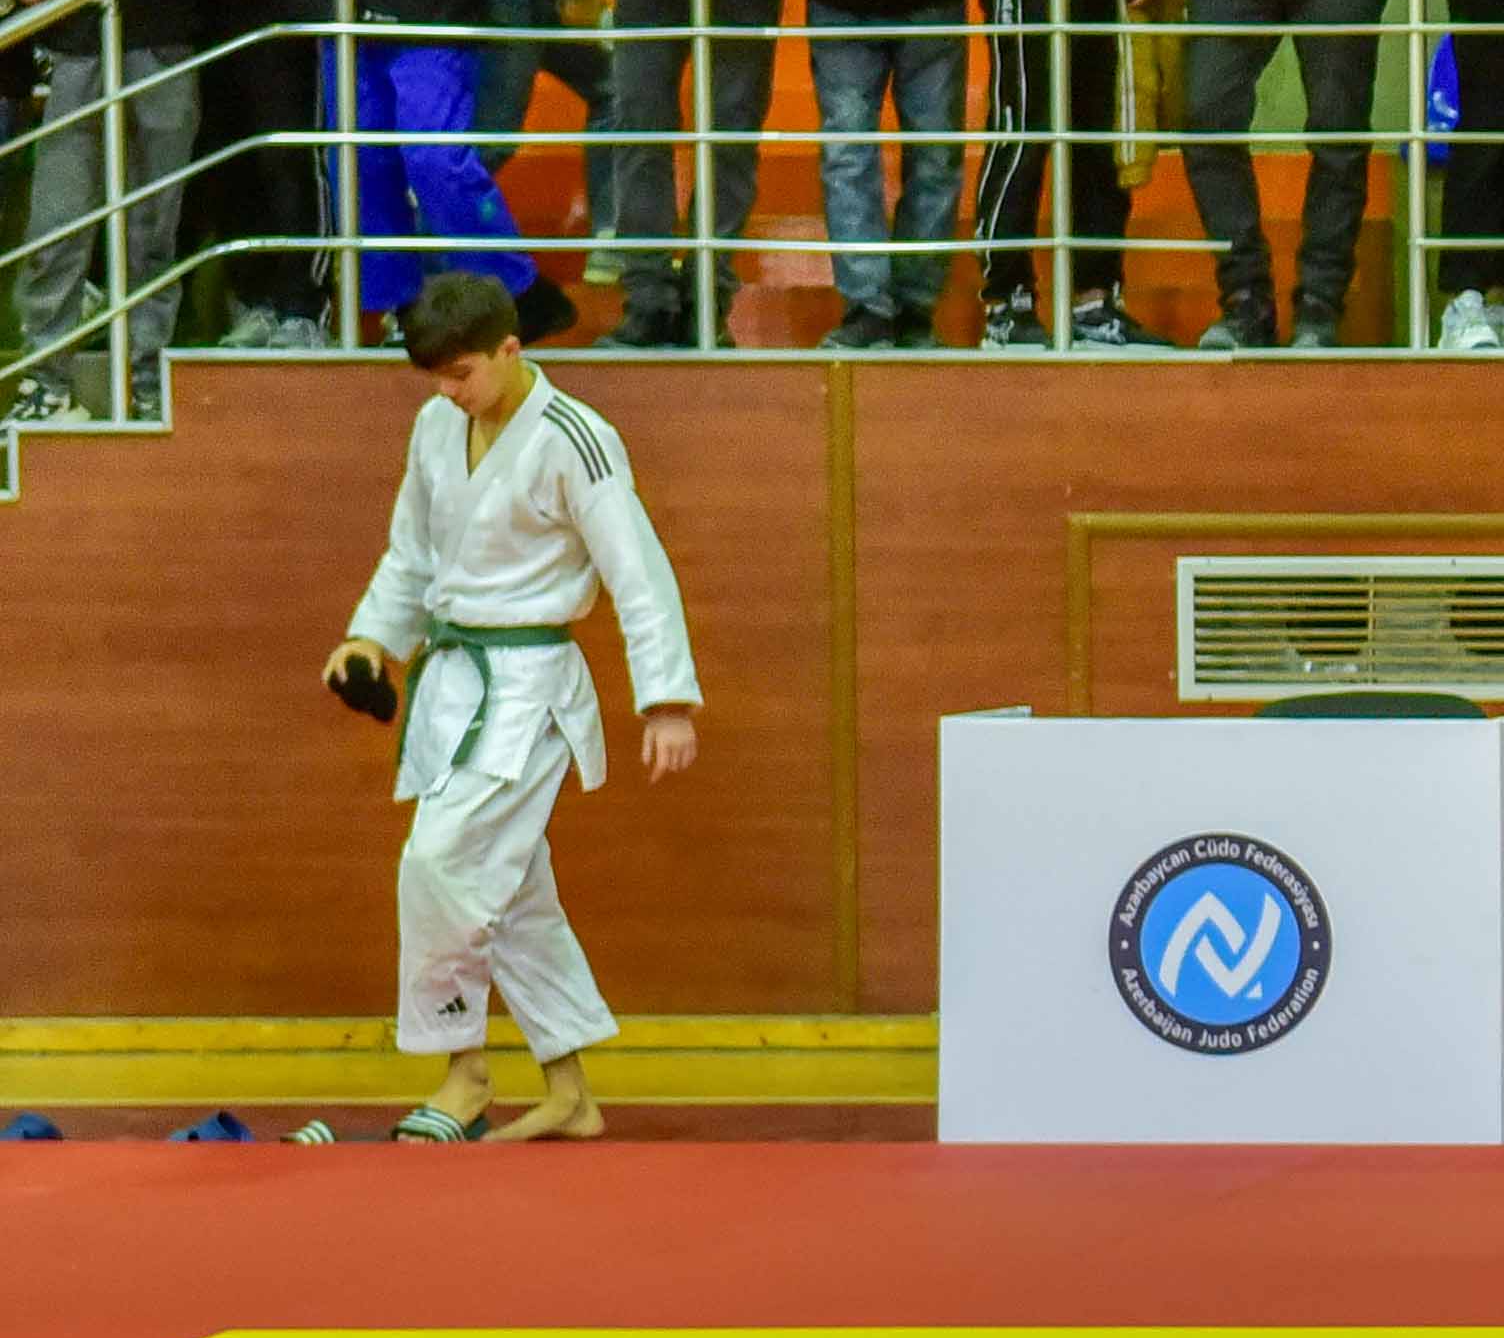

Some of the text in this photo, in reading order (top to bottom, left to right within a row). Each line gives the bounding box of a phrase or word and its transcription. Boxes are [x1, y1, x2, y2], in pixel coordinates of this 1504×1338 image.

[1194, 838, 1241, 859] Cüdo
[1244, 843, 1319, 928] Federasiyası
[1122, 967, 1319, 1049] Azerbaijan Judo Federation
